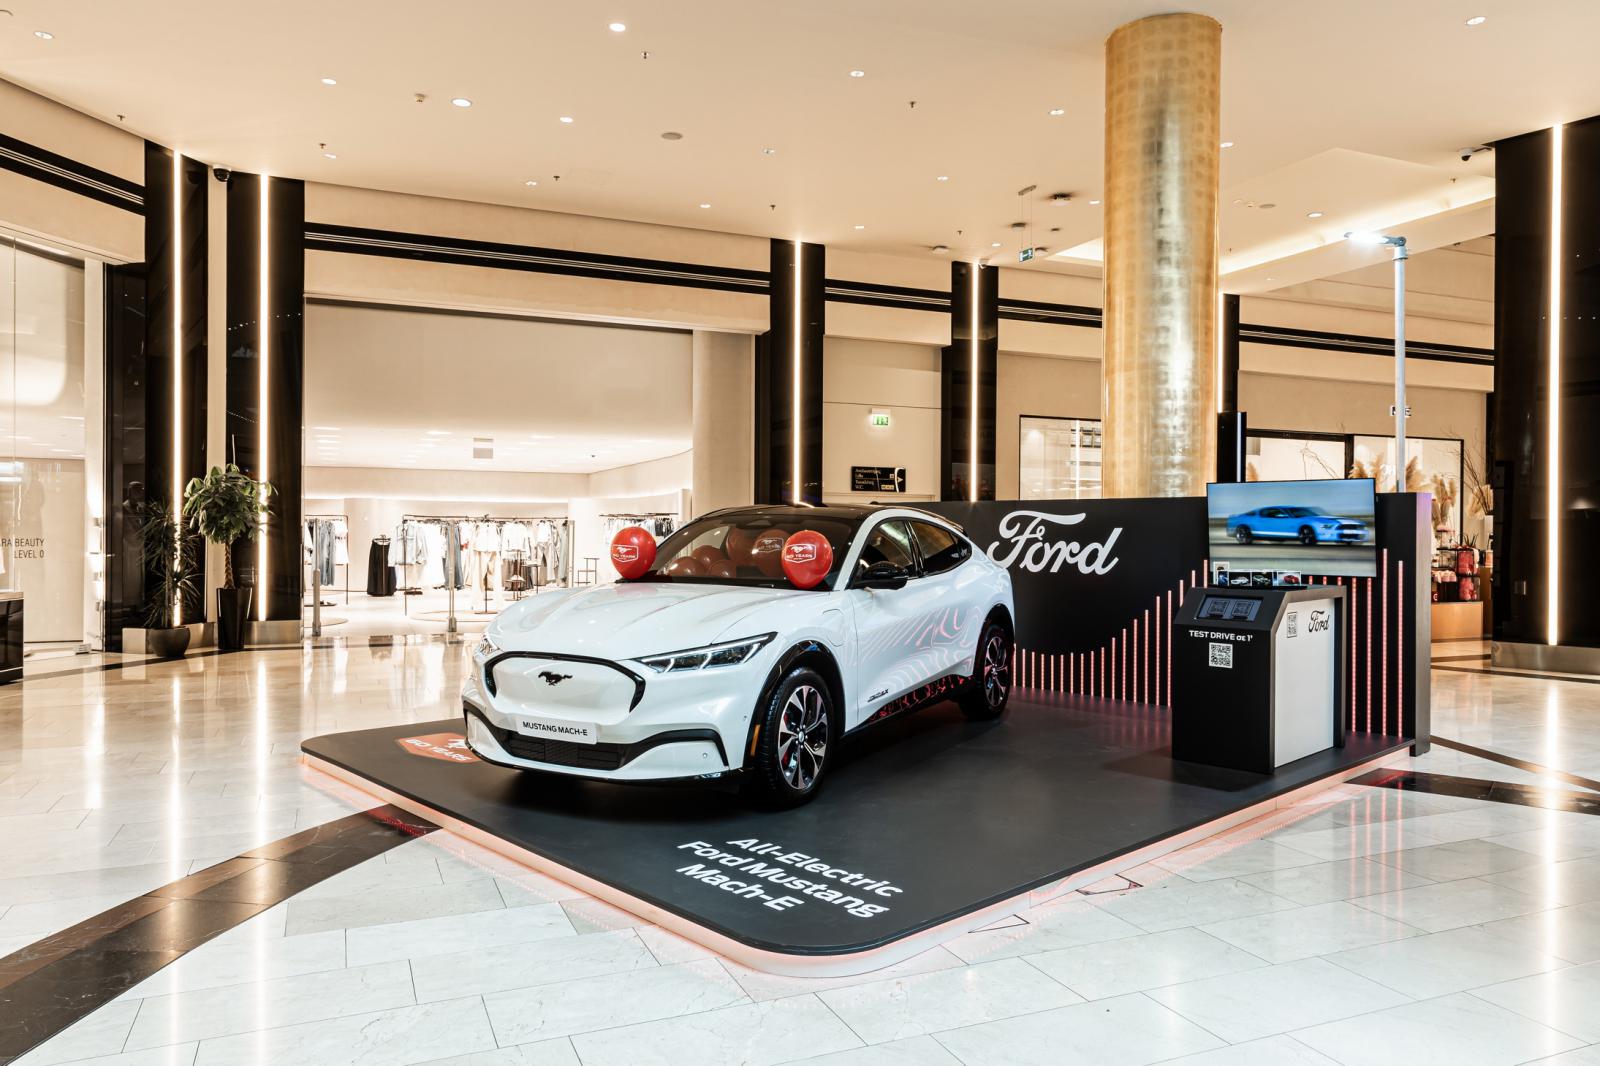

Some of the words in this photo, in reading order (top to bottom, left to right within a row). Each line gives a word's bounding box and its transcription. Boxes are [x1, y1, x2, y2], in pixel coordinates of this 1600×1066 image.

[0, 538, 12, 547] RA
[14, 538, 45, 547] BEAUTY
[987, 510, 1123, 575] Ford
[14, 549, 37, 559] LEVEL
[1308, 610, 1330, 632] Ford
[1189, 629, 1209, 638] TEST
[1210, 631, 1235, 641] DRIVE
[522, 720, 557, 733] MUSTANG
[557, 724, 588, 736] MACH-E
[431, 746, 472, 761] YEARS
[726, 838, 904, 897] All-Electric
[676, 863, 805, 911] Mach-E
[677, 840, 755, 867] Ford
[739, 861, 890, 918] Mustang
